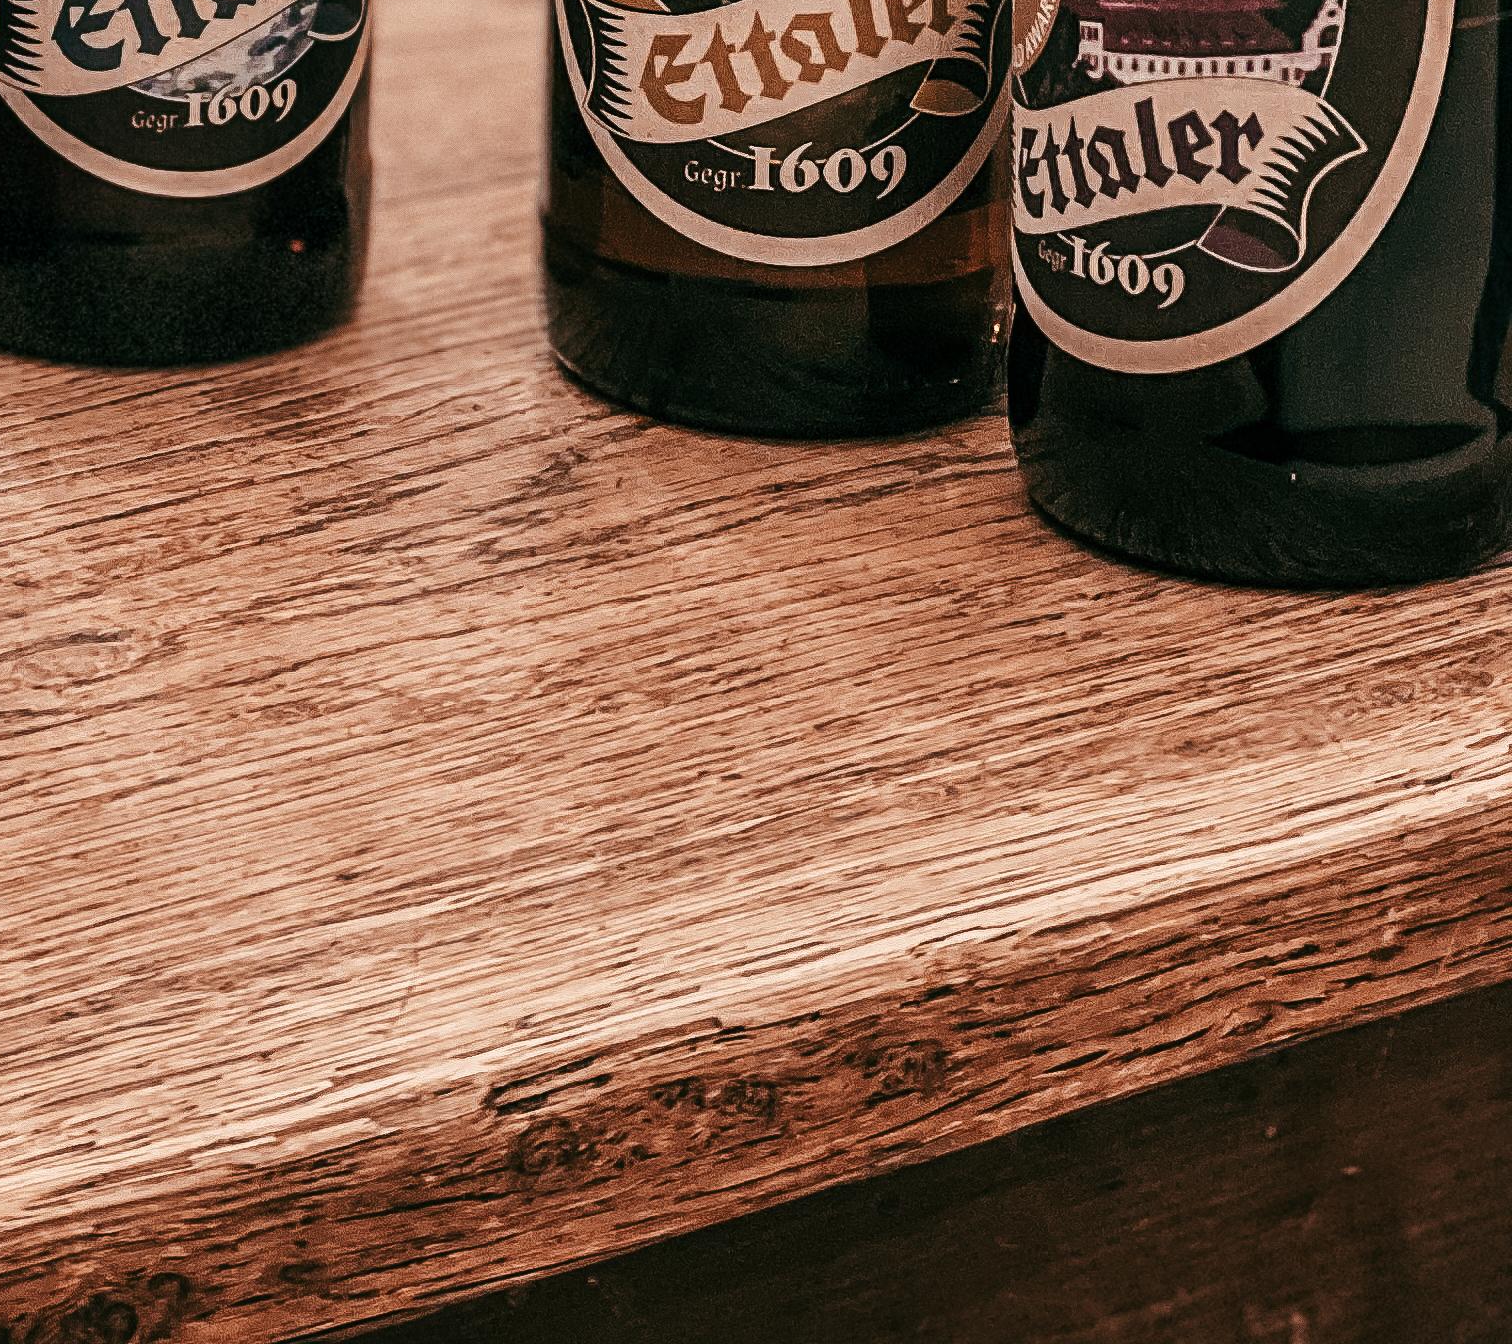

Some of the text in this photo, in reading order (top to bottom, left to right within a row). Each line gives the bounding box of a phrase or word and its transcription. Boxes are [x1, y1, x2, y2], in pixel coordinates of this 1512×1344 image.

[183, 79, 297, 127] 1609
[748, 141, 907, 200] 1609
[1020, 96, 1265, 219] Ettaler
[1070, 234, 1186, 309] 1609
